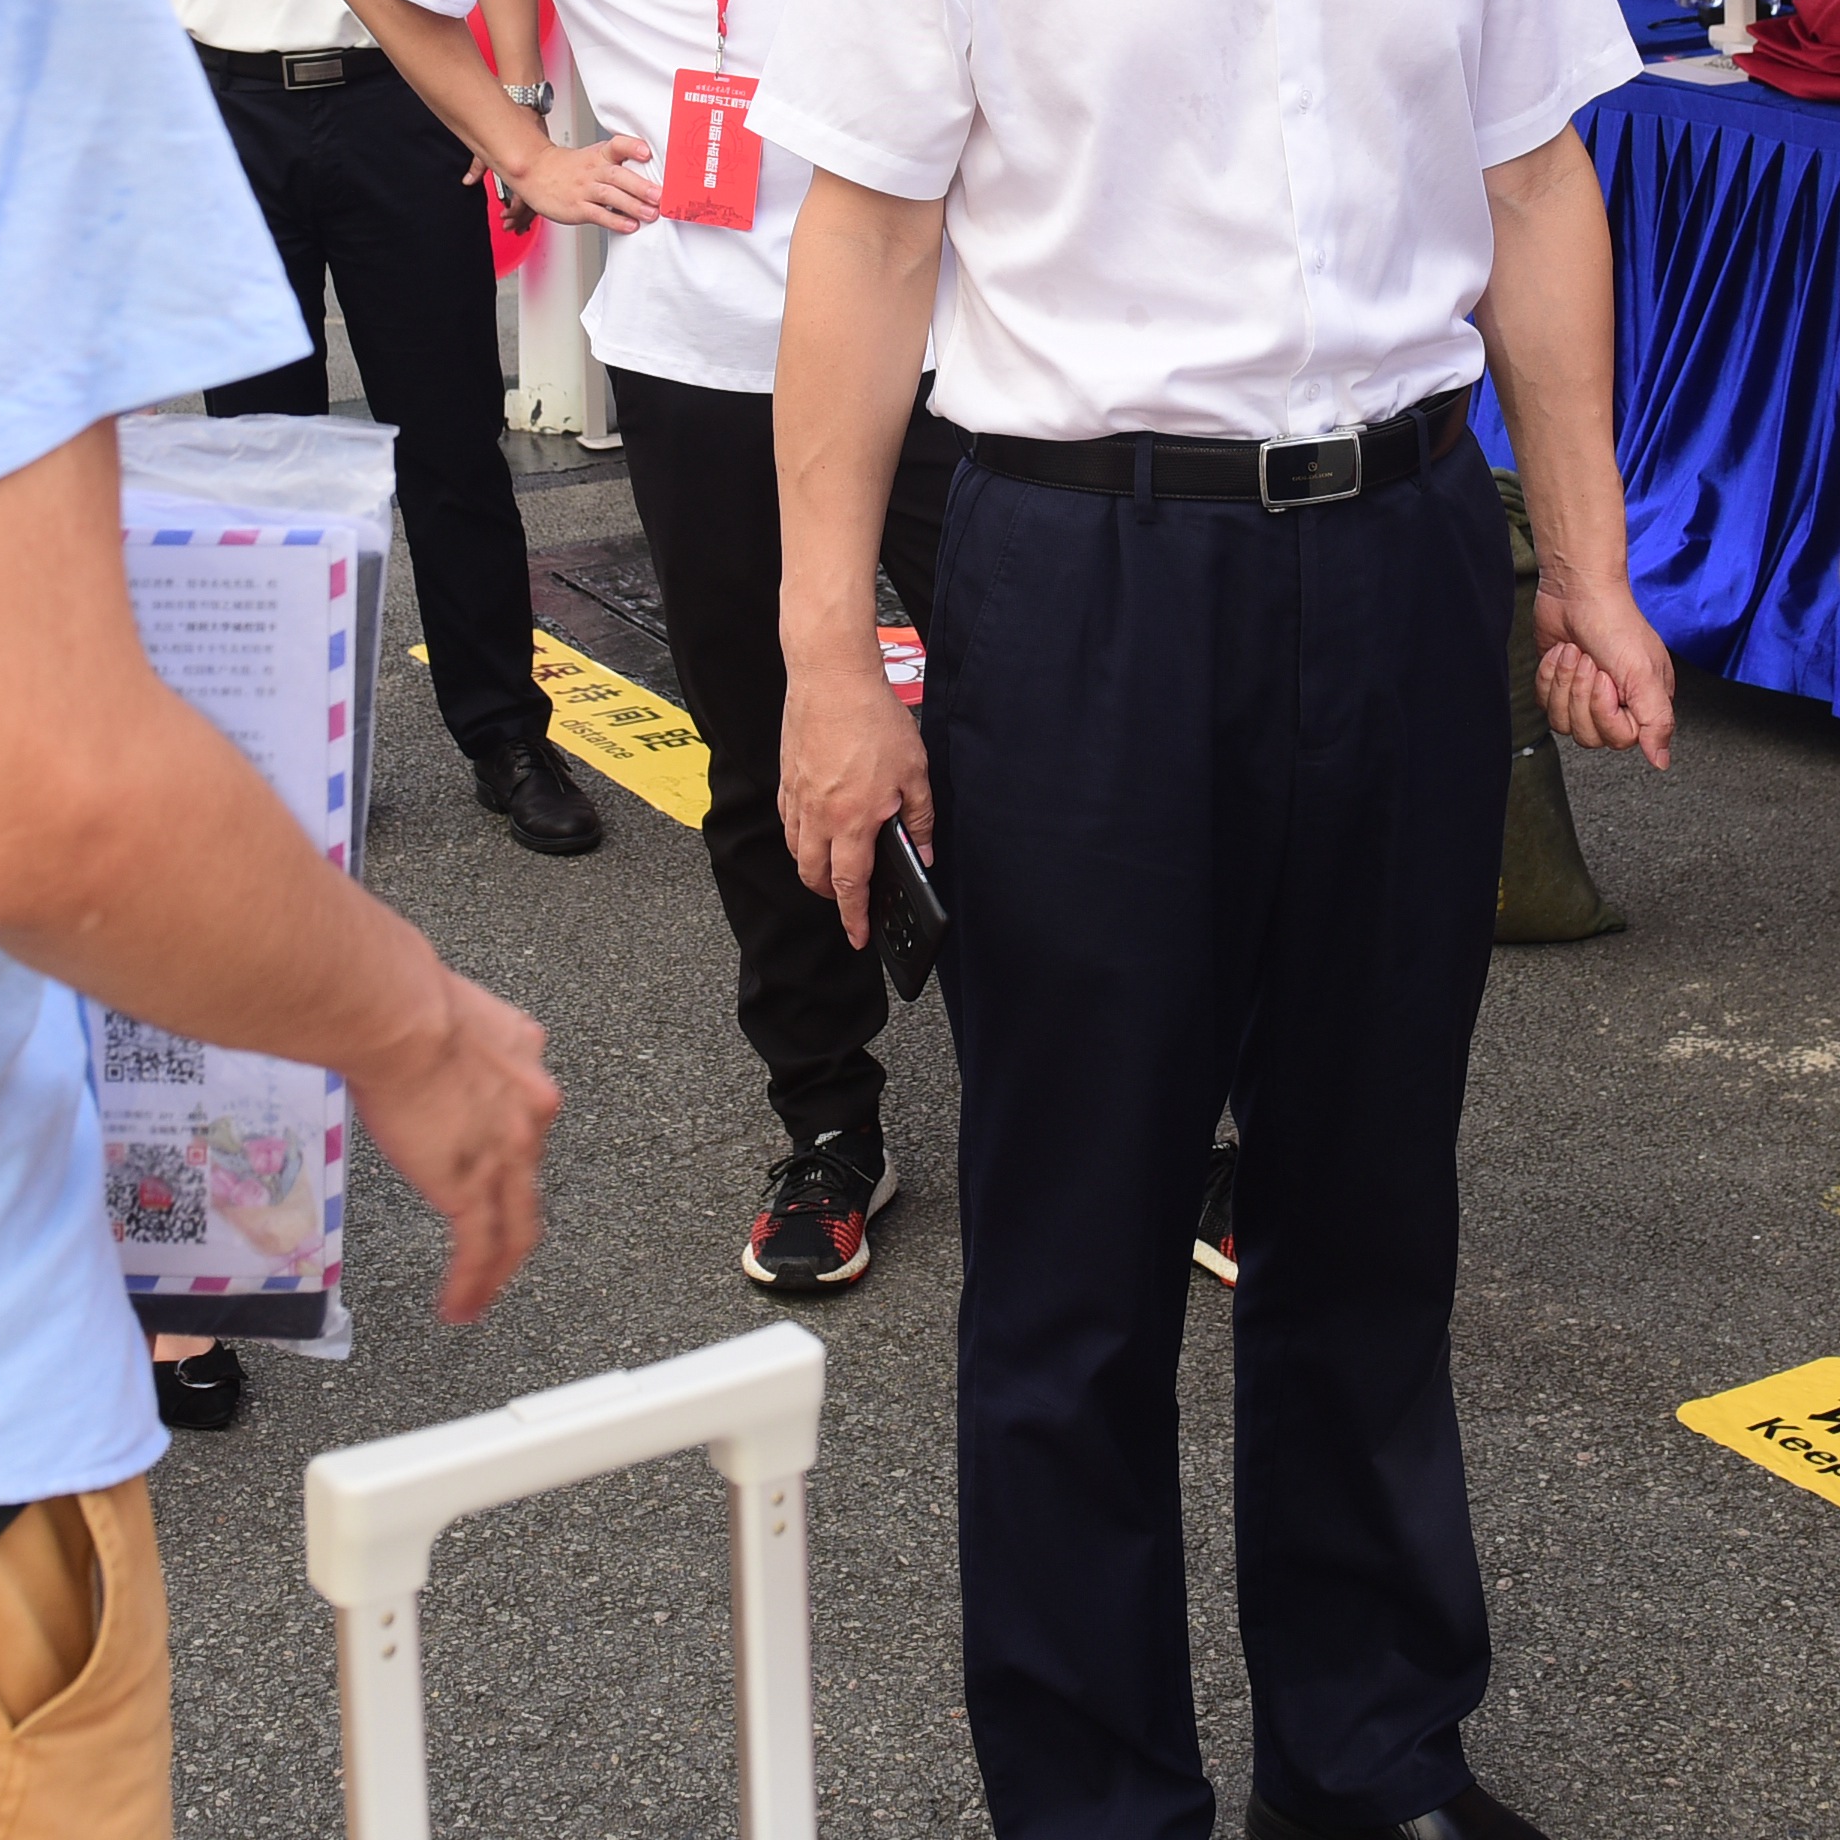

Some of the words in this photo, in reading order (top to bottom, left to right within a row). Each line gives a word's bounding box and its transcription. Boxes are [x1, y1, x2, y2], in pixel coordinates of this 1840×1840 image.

[703, 108, 725, 189] 迎新志愿者
[559, 718, 635, 760] distance
